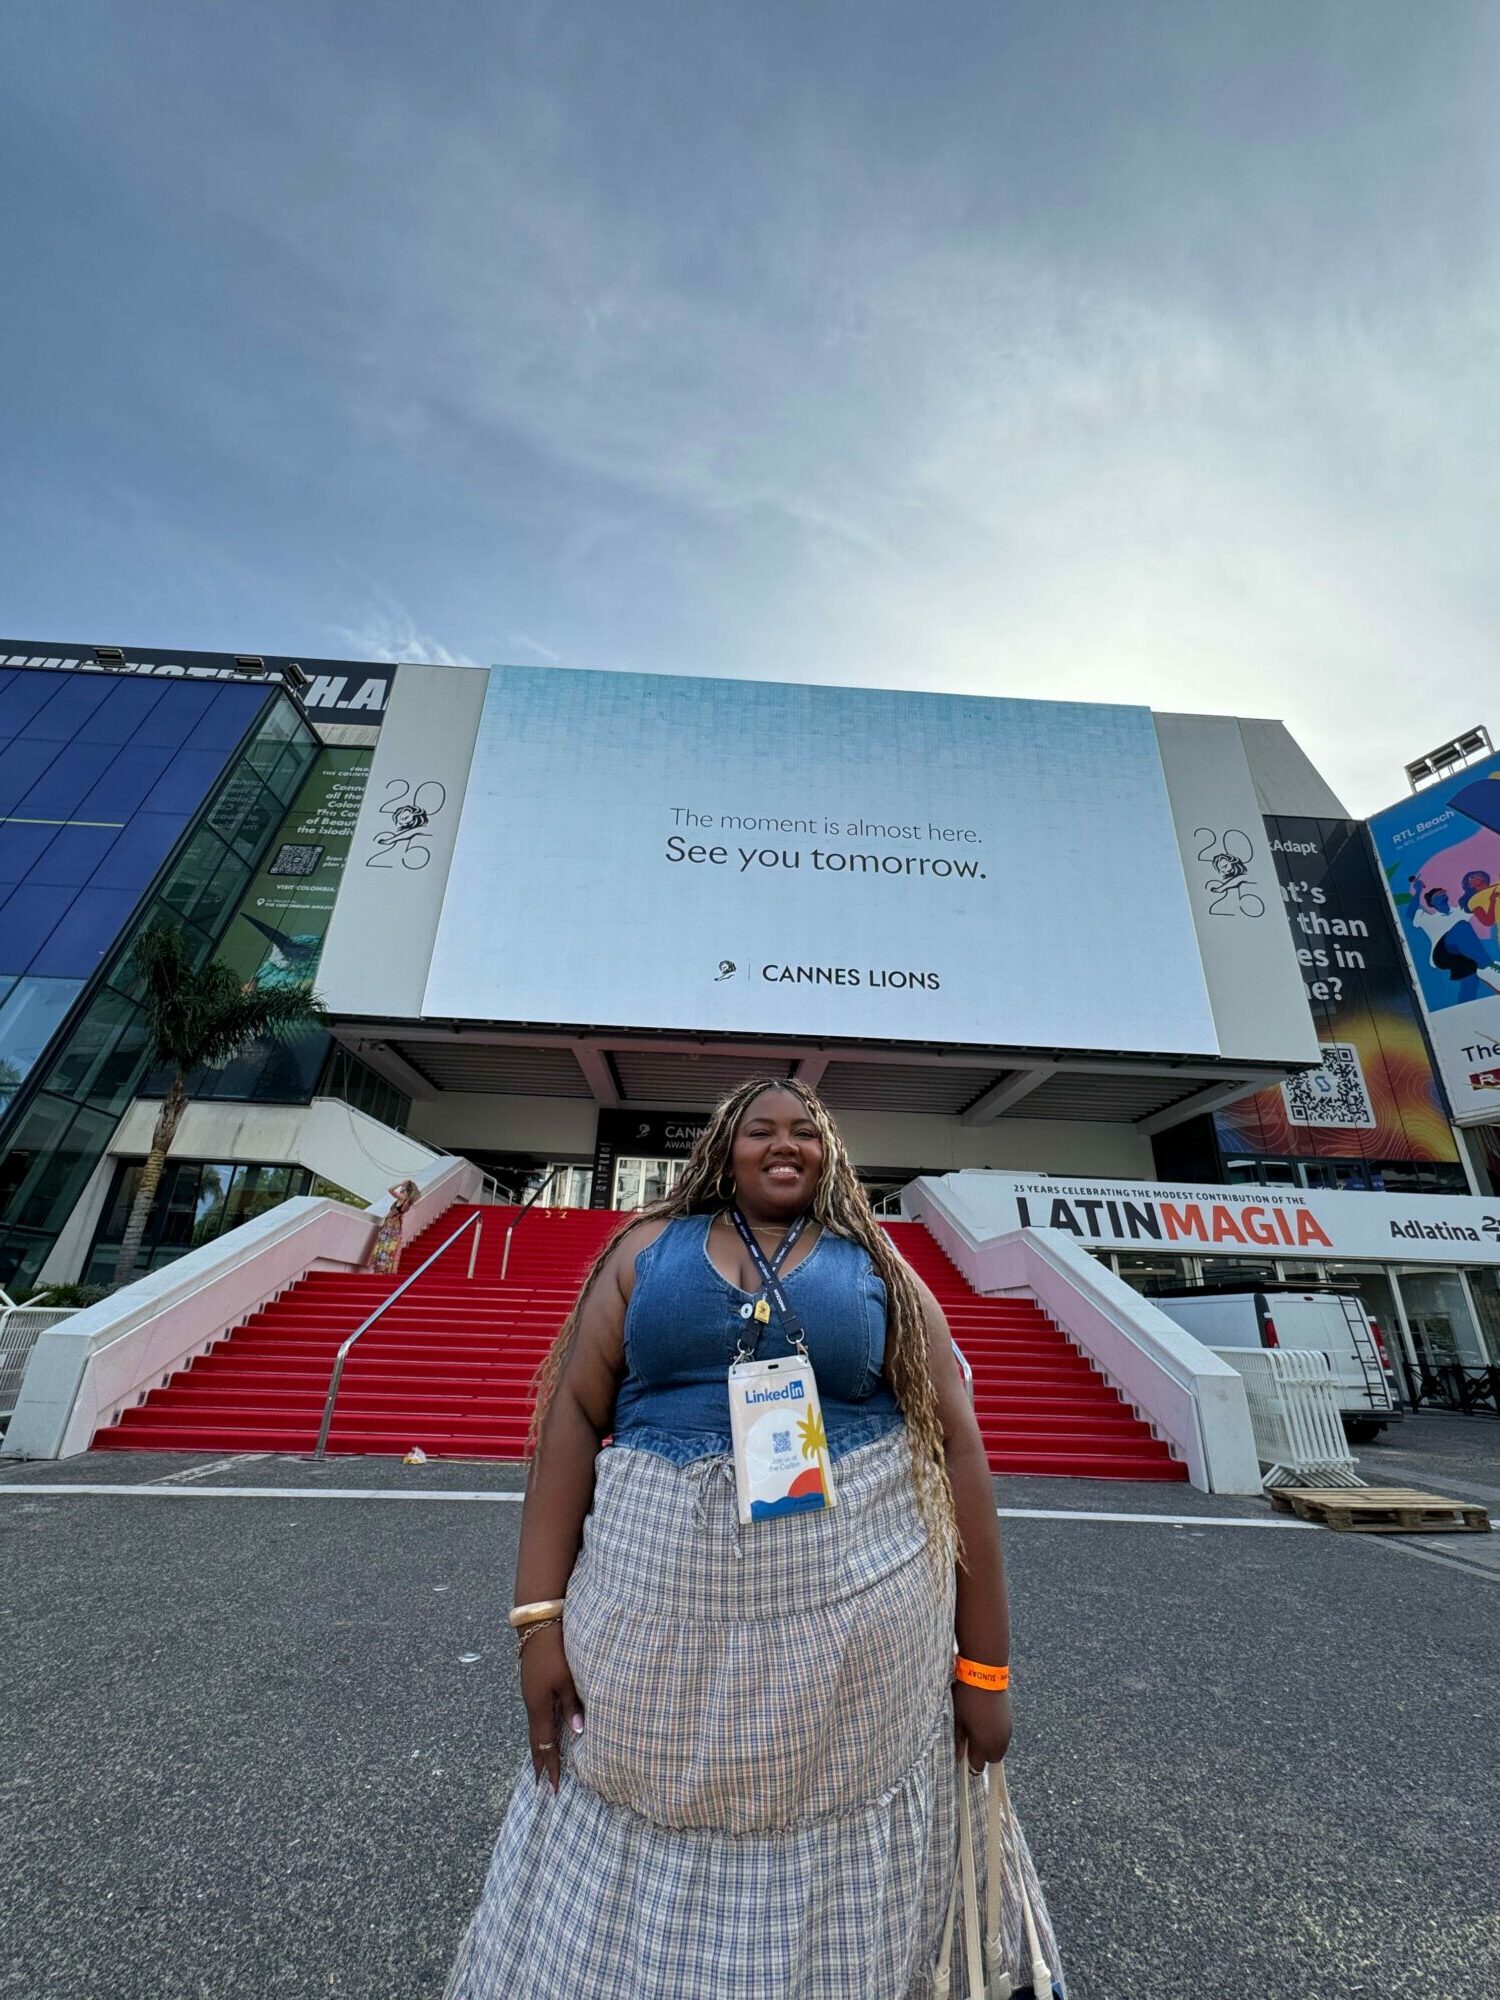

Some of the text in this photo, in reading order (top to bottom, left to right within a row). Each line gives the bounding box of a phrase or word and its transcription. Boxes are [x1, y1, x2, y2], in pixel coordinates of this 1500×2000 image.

[325, 791, 362, 801] all the
[305, 816, 321, 825] of
[316, 808, 337, 817] The
[296, 824, 316, 834] the
[670, 807, 983, 844] The moment is almost here.
[1392, 828, 1415, 844] RTL
[1416, 809, 1455, 833] Beach
[665, 835, 987, 880] See you tomorrow.
[1297, 911, 1369, 938] than
[1333, 943, 1367, 970] in
[762, 964, 941, 990] CANNES LIONS
[1014, 1184, 1307, 1206] 25 YEARS CELEBRATING THE MODEST CONTRIBUTION OF THE
[1389, 1219, 1481, 1242] Adlatina
[968, 1668, 997, 1682] SUNDAY
